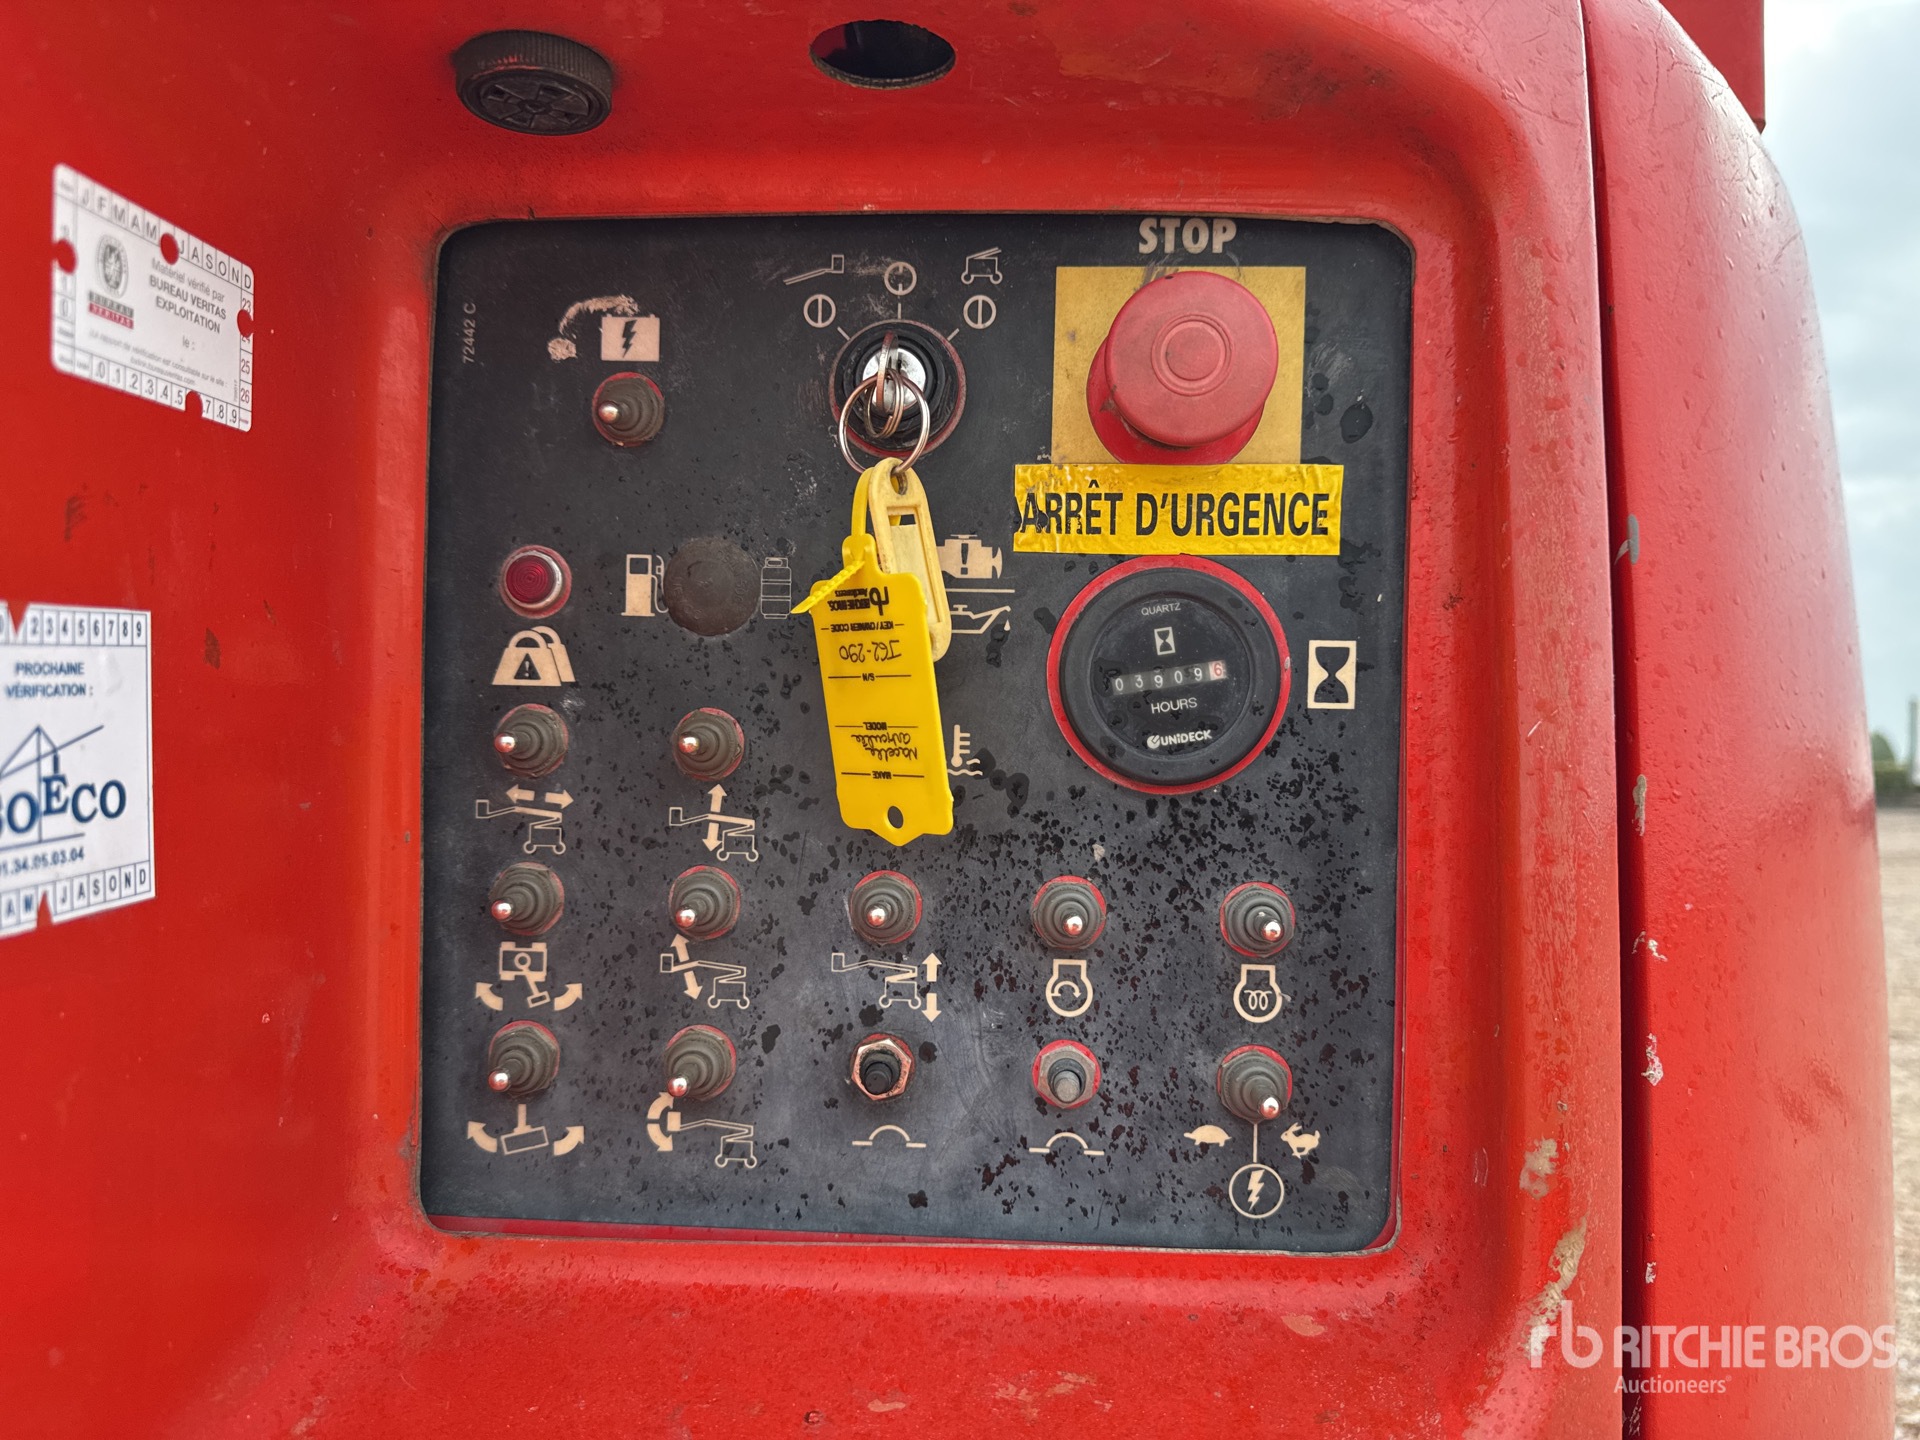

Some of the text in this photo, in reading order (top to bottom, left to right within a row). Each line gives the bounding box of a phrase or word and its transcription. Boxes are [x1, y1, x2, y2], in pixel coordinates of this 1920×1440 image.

[1139, 218, 1237, 254] STOP
[149, 274, 226, 320] BUREAU VERITAS
[212, 290, 225, 303] par
[155, 295, 220, 333] EXPLOITATION
[463, 302, 476, 364] 72442 C
[182, 336, 189, 347] le
[241, 358, 250, 375] 25
[241, 388, 250, 404] 26
[1018, 479, 1330, 536] ARRÊT D'URGENCE
[1141, 602, 1181, 616] QUARTZ
[831, 623, 849, 632] CODE
[850, 622, 875, 632] OWNER
[879, 621, 894, 631] KEY
[15, 662, 85, 676] PROCHAINE
[862, 672, 875, 681] S/N
[6, 682, 86, 698] VÉRIFICATION
[1151, 697, 1198, 714] HOURS
[863, 721, 887, 731] MODEL
[872, 770, 891, 780] MAKE
[0, 773, 126, 839] OECO
